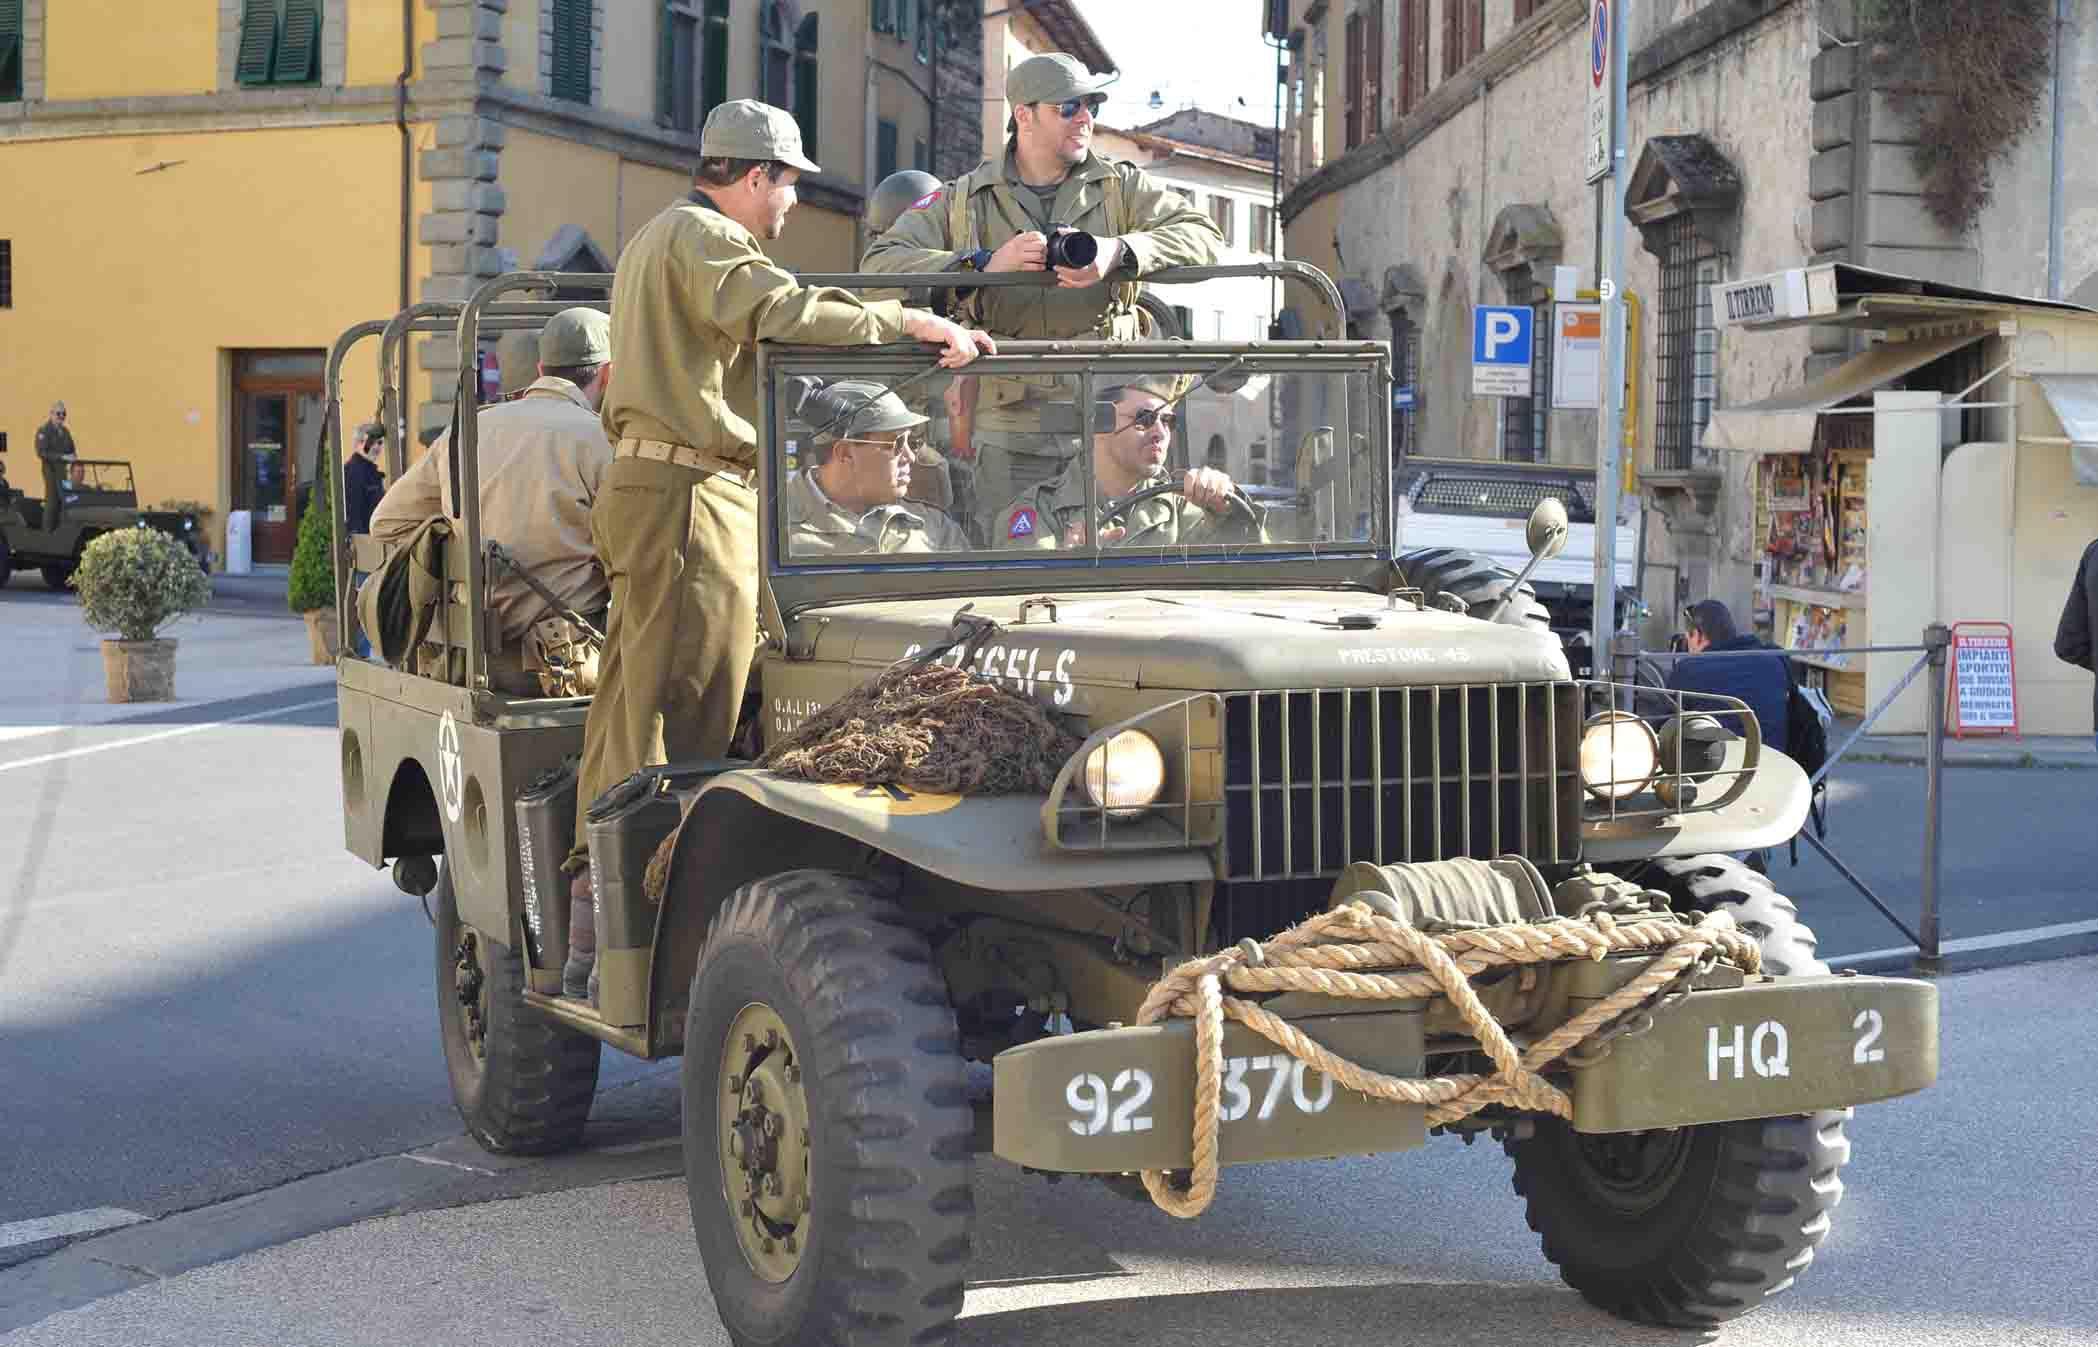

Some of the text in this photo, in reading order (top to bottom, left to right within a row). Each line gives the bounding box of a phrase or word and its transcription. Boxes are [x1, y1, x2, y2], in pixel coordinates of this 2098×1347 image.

[1485, 312, 1520, 359] P
[1958, 650, 2009, 661] IMPIANTI
[1958, 663, 2010, 673] SPORTIVI
[1708, 1008, 1885, 1081] HQ 2
[1066, 1054, 1333, 1136] 92 370
